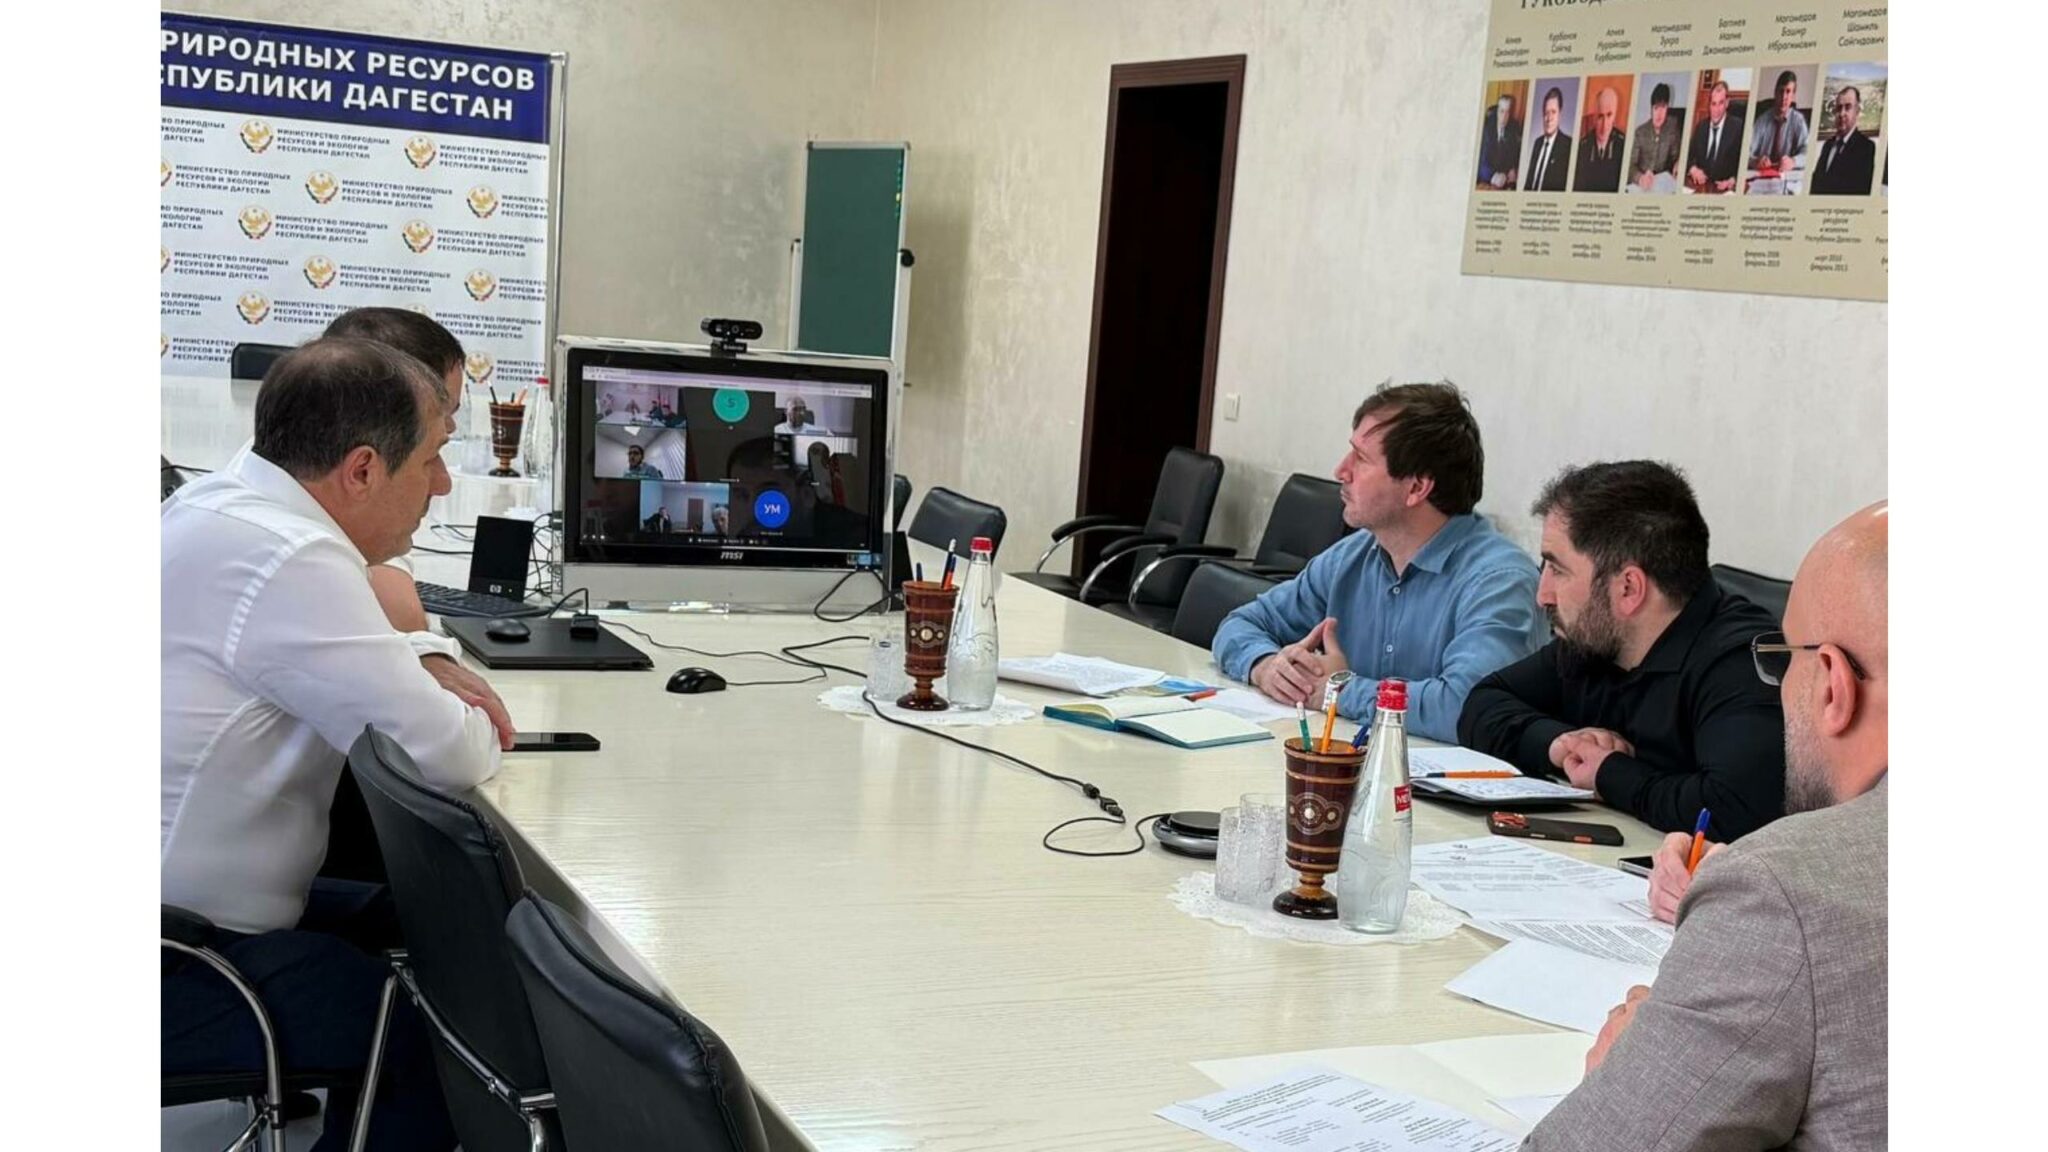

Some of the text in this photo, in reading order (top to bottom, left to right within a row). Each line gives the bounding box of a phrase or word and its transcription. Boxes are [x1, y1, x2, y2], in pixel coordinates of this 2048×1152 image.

[161, 64, 513, 121] ПУБЛИКИ ДАГЕСТАН
[367, 52, 535, 90] РЕСУРСОВ
